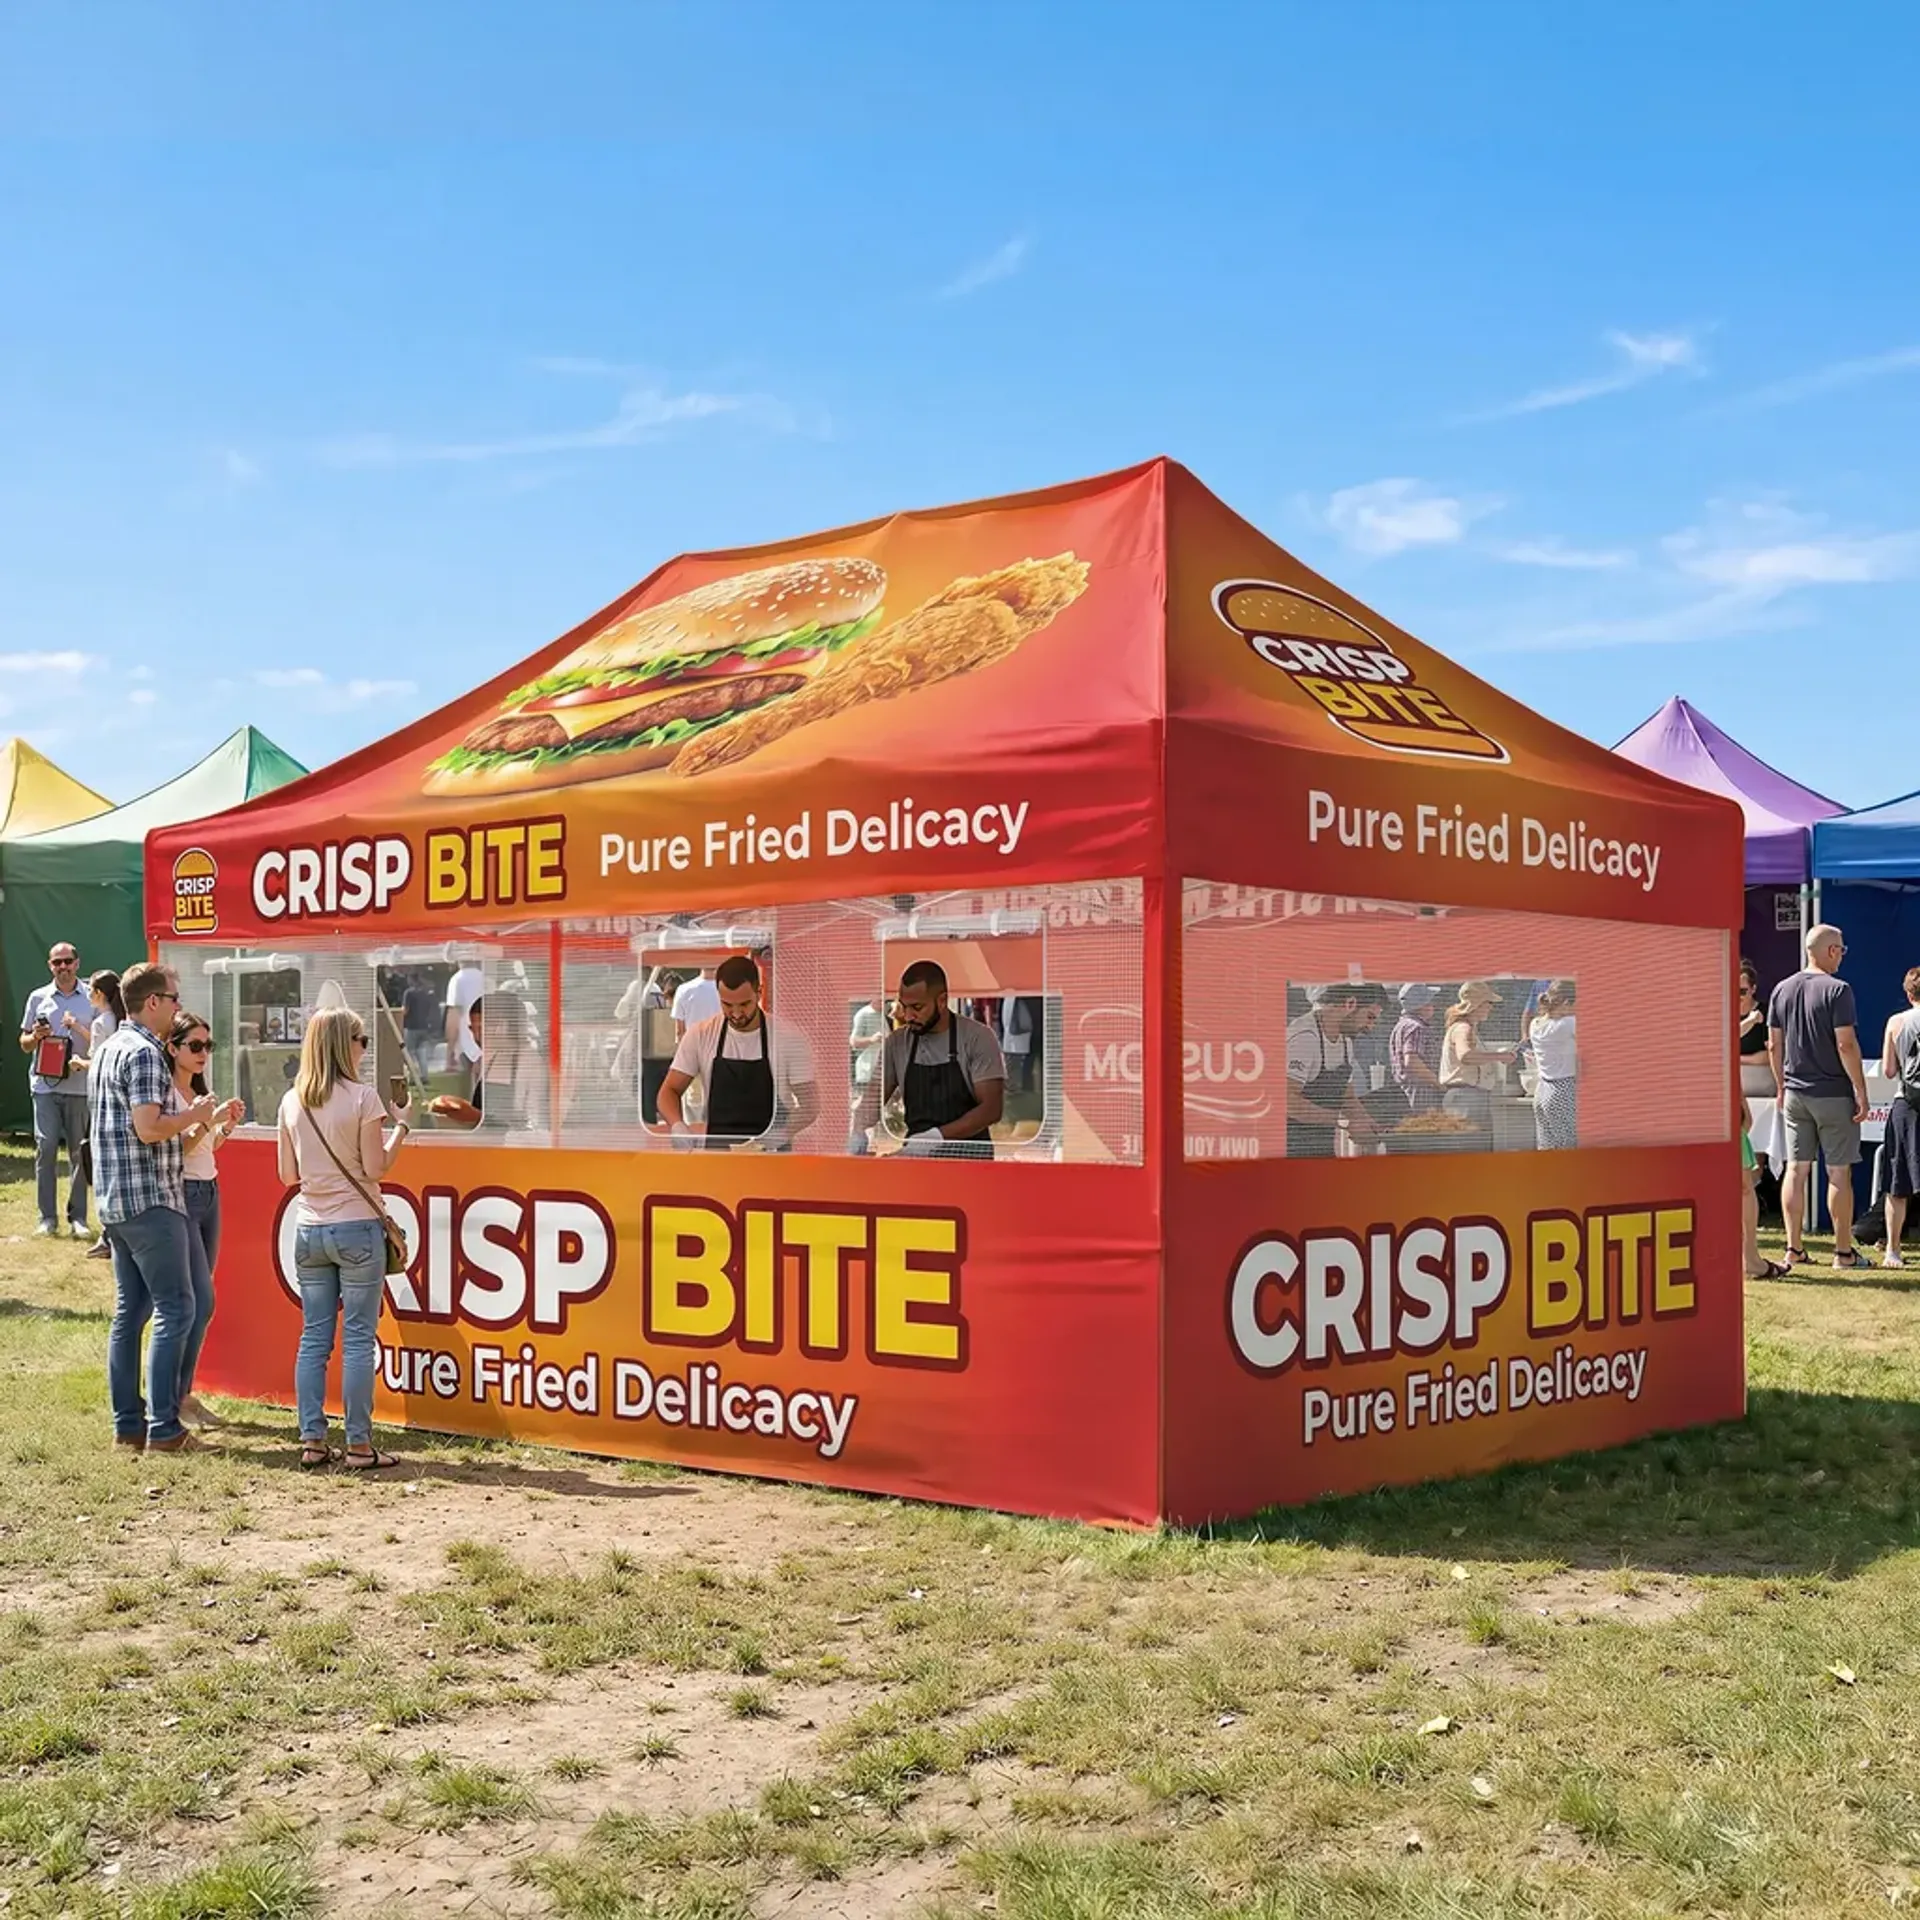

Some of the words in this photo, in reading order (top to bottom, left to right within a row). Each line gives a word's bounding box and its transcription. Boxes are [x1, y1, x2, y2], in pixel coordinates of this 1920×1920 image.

[1251, 635, 1411, 684] CRISP
[1293, 675, 1471, 732] BITE
[252, 839, 411, 917] CRISP
[428, 822, 563, 904] BITE
[600, 833, 691, 876] Pure
[703, 811, 810, 867] Fried
[825, 797, 1029, 856] Delicacy
[1307, 790, 1404, 852] Pure
[1416, 804, 1509, 864] Fried
[1521, 818, 1661, 891] Delicacy
[174, 877, 215, 895] CRISP
[175, 895, 214, 917] BITE
[651, 1205, 959, 1360] BITE
[1231, 1225, 1507, 1369] CRISP
[1531, 1207, 1695, 1329] BITE
[374, 1339, 459, 1397] ure
[473, 1346, 598, 1413] Fried
[615, 1362, 856, 1457] Delicacy
[1303, 1390, 1395, 1443] Pure
[1406, 1360, 1498, 1426] Fried
[1509, 1346, 1647, 1407] Delicacy
